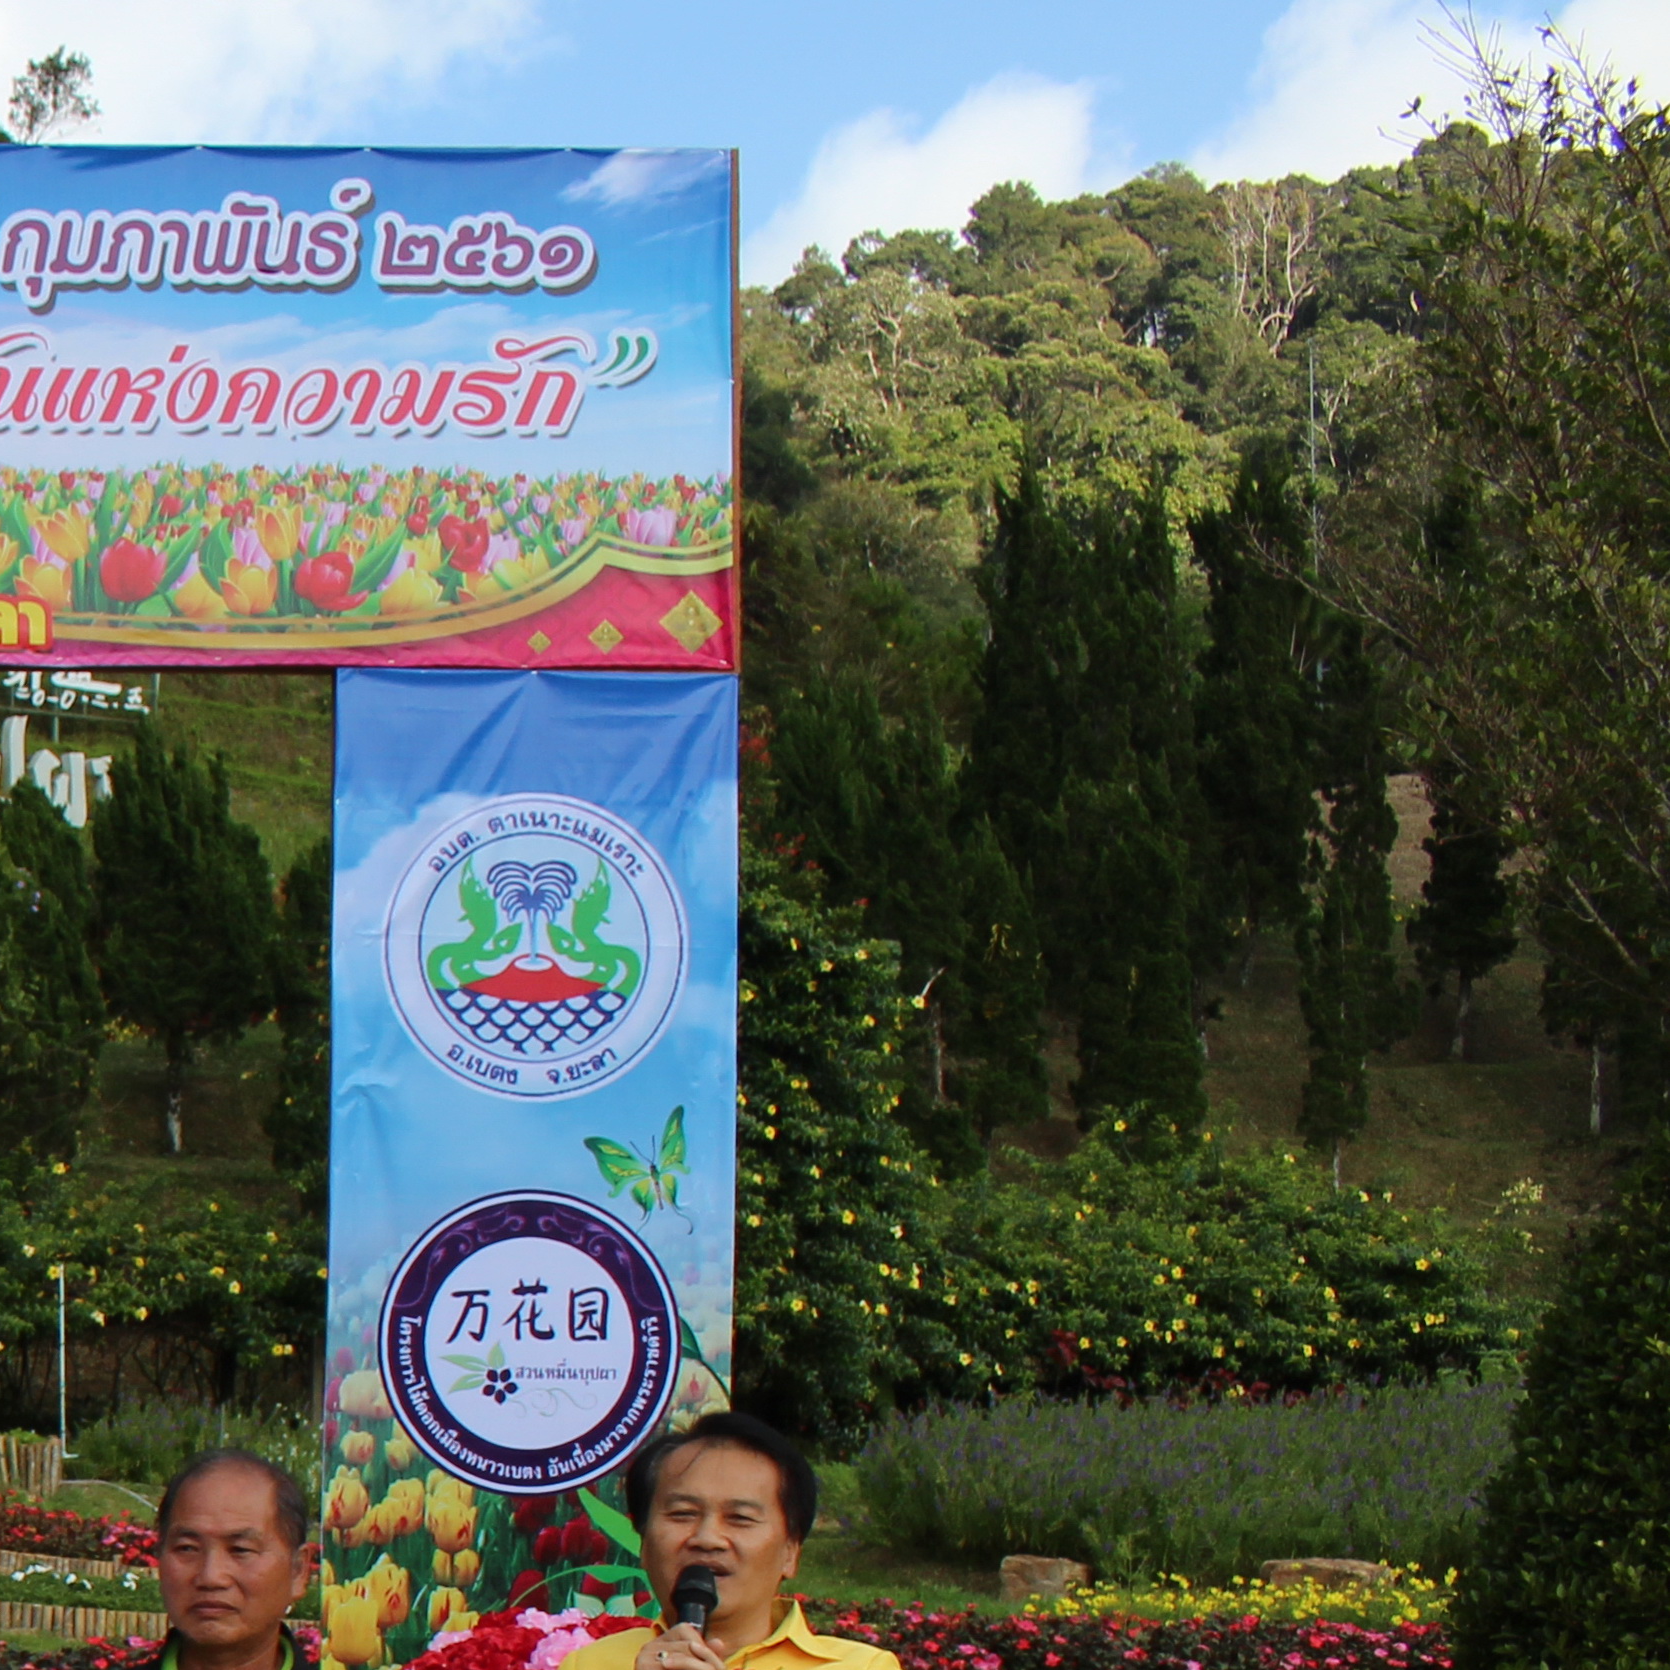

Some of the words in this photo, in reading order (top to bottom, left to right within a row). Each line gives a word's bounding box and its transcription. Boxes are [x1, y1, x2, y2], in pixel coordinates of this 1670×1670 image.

[0, 182, 370, 302] กุมภาพันธ์
[378, 214, 590, 283] ๒๕๖๑
[428, 829, 480, 874] อบต.
[445, 1042, 519, 1085] อ.เบตง
[545, 1046, 618, 1085] จ.ยะลา
[445, 1277, 610, 1344] 万花园
[515, 1358, 617, 1386] สวนหมื่นบุปผา
